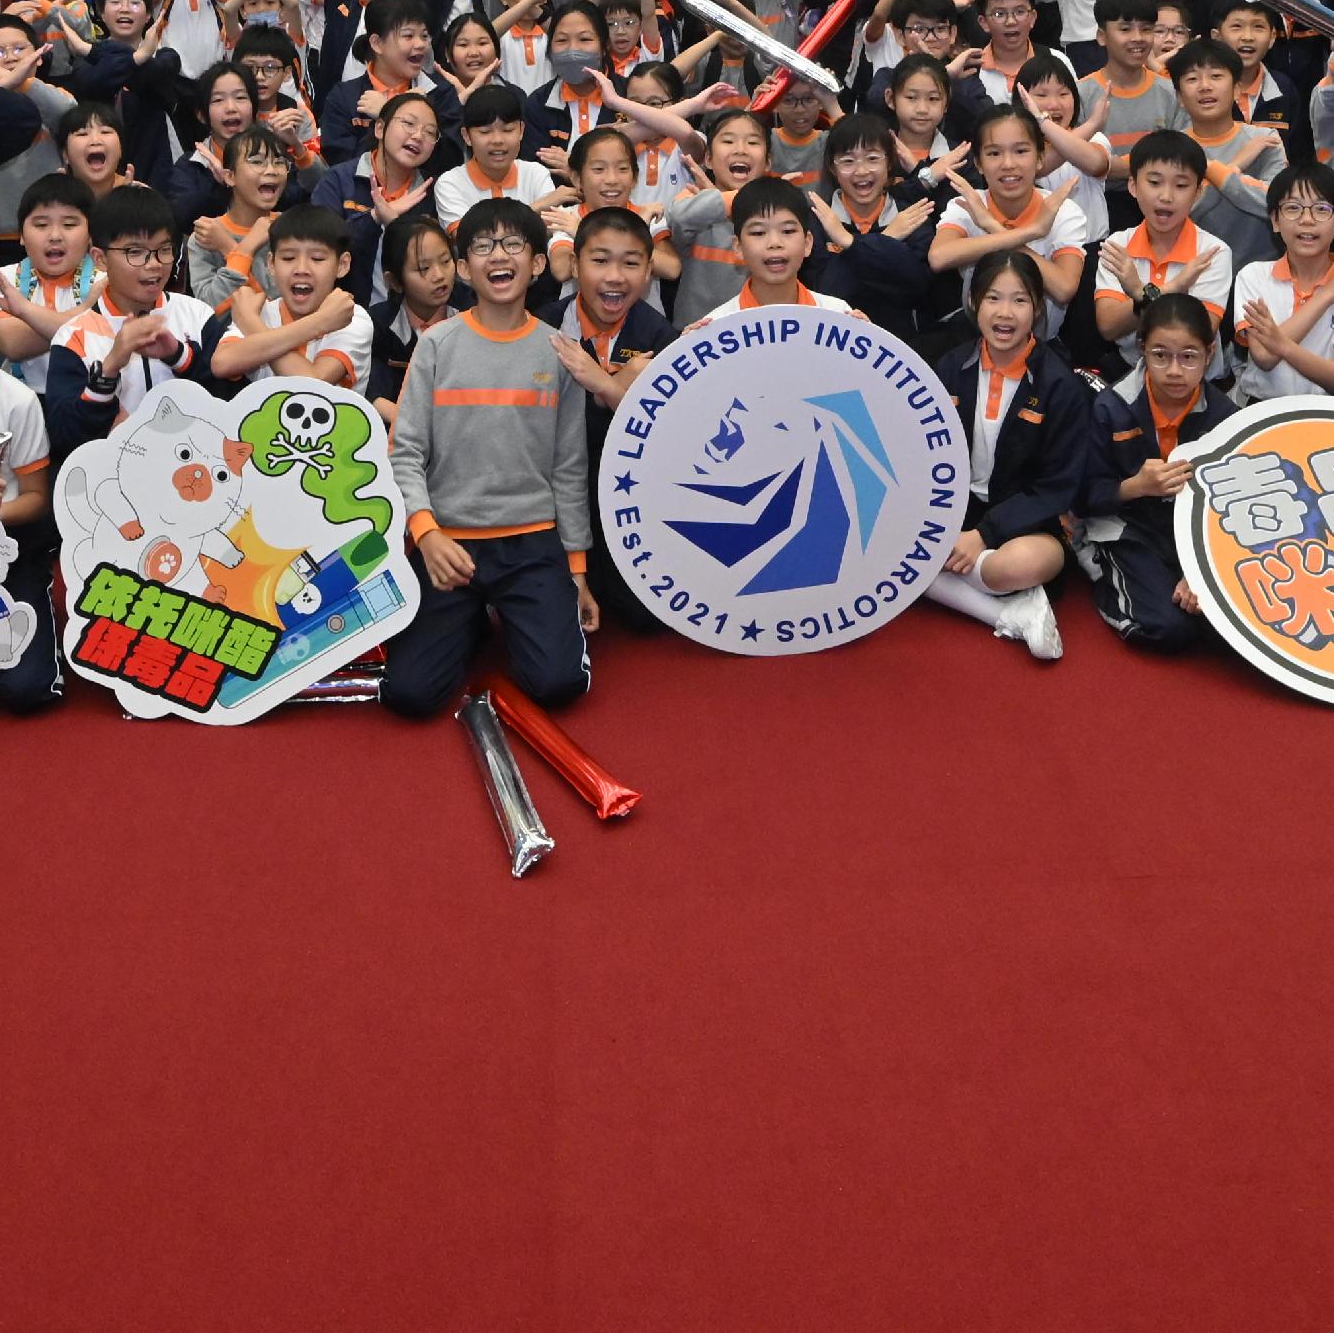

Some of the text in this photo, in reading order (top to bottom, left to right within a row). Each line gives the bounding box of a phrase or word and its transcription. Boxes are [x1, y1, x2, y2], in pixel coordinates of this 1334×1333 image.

[618, 318, 956, 643] LEADERSHIP INSTITUTE ON NARCOTICS
[75, 616, 225, 710] 係毒品
[80, 566, 277, 677] 依托咪酯
